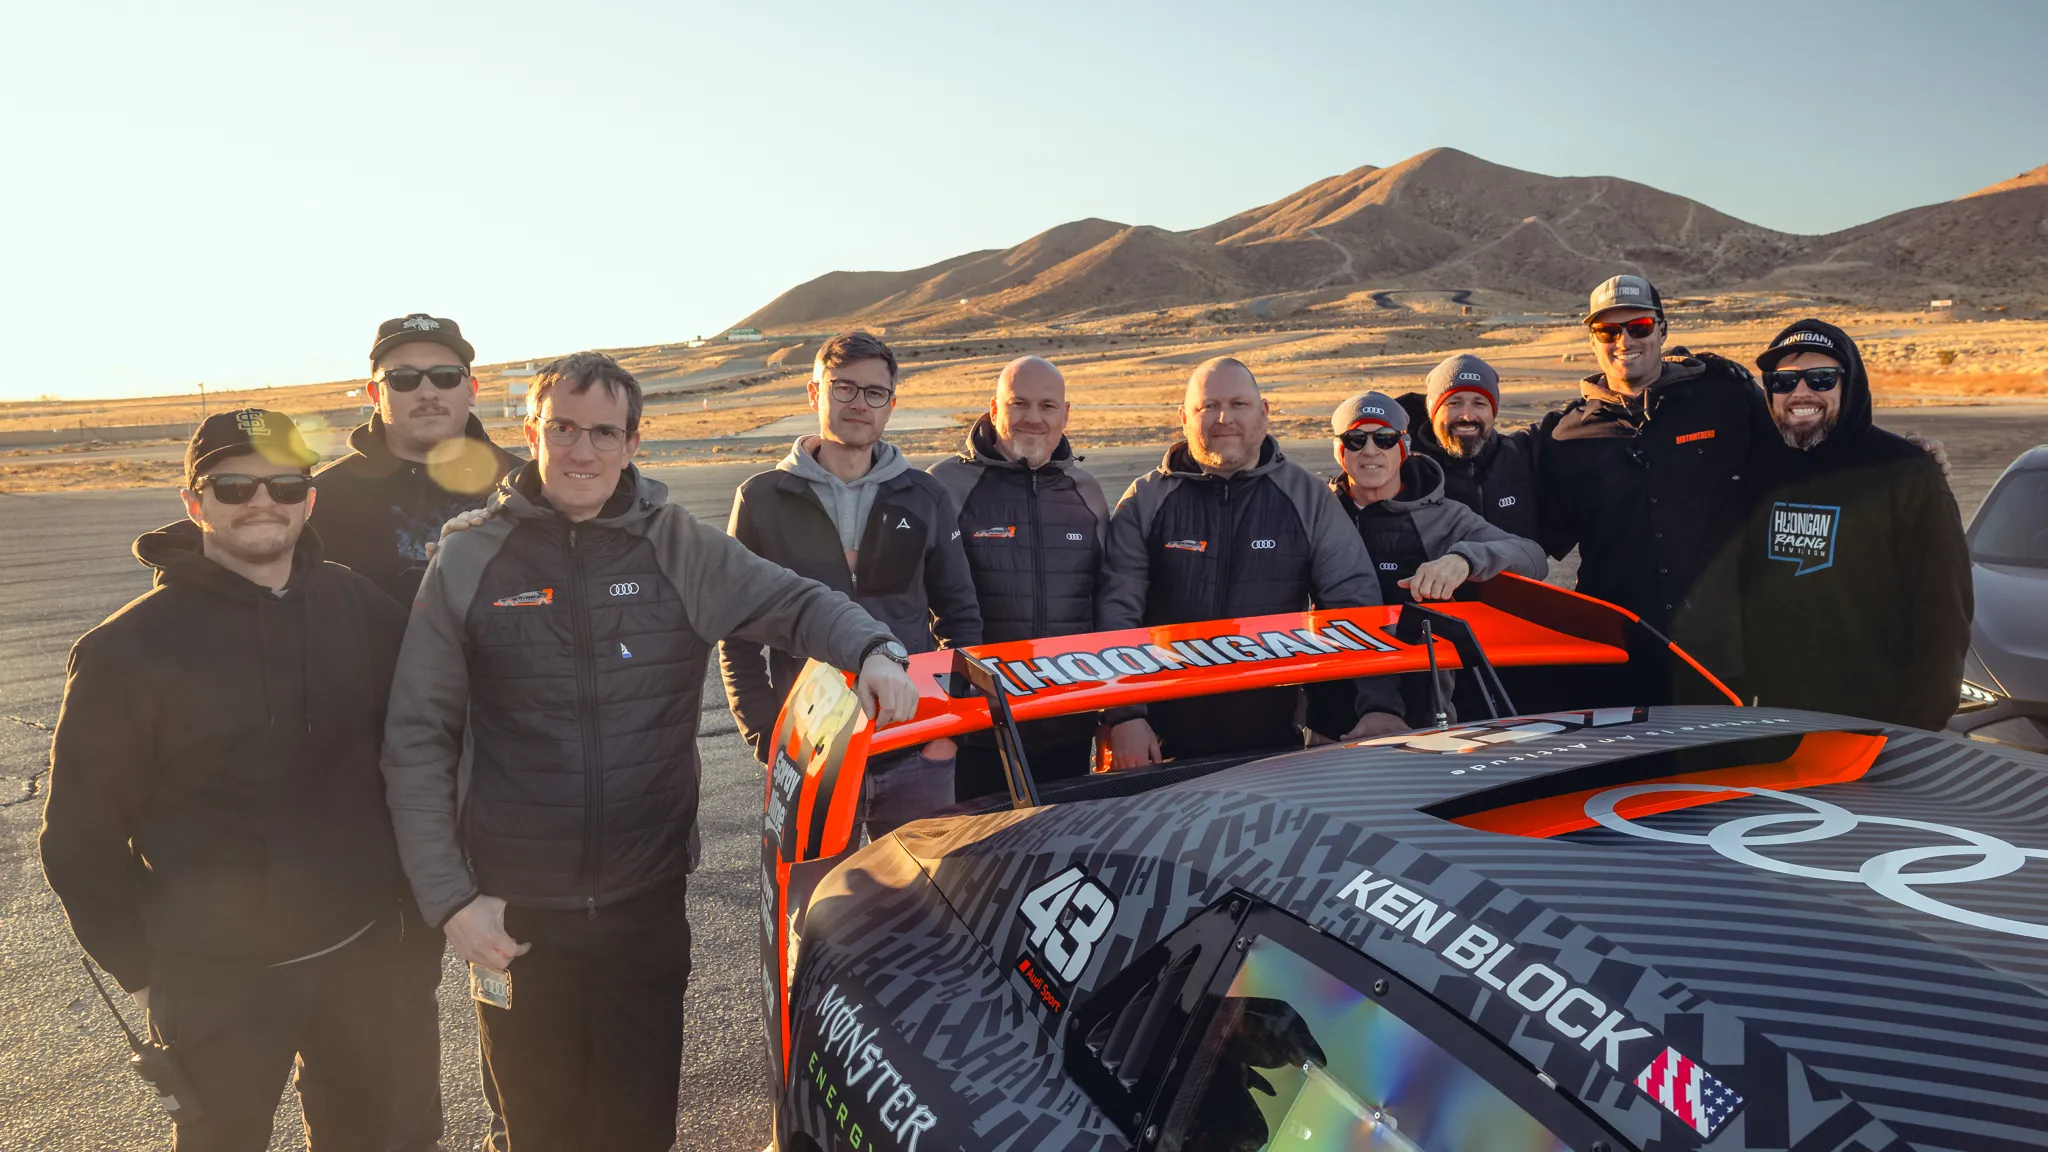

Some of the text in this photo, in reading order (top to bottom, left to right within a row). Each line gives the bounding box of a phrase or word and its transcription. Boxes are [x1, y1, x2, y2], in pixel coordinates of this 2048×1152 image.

[1774, 533, 1826, 550] RACNG
[1019, 866, 1116, 983] 43
[1336, 869, 1654, 1073] KEN BLOCK
[1026, 967, 1061, 1013] Audi Sport
[808, 1051, 873, 1152] ENERG
